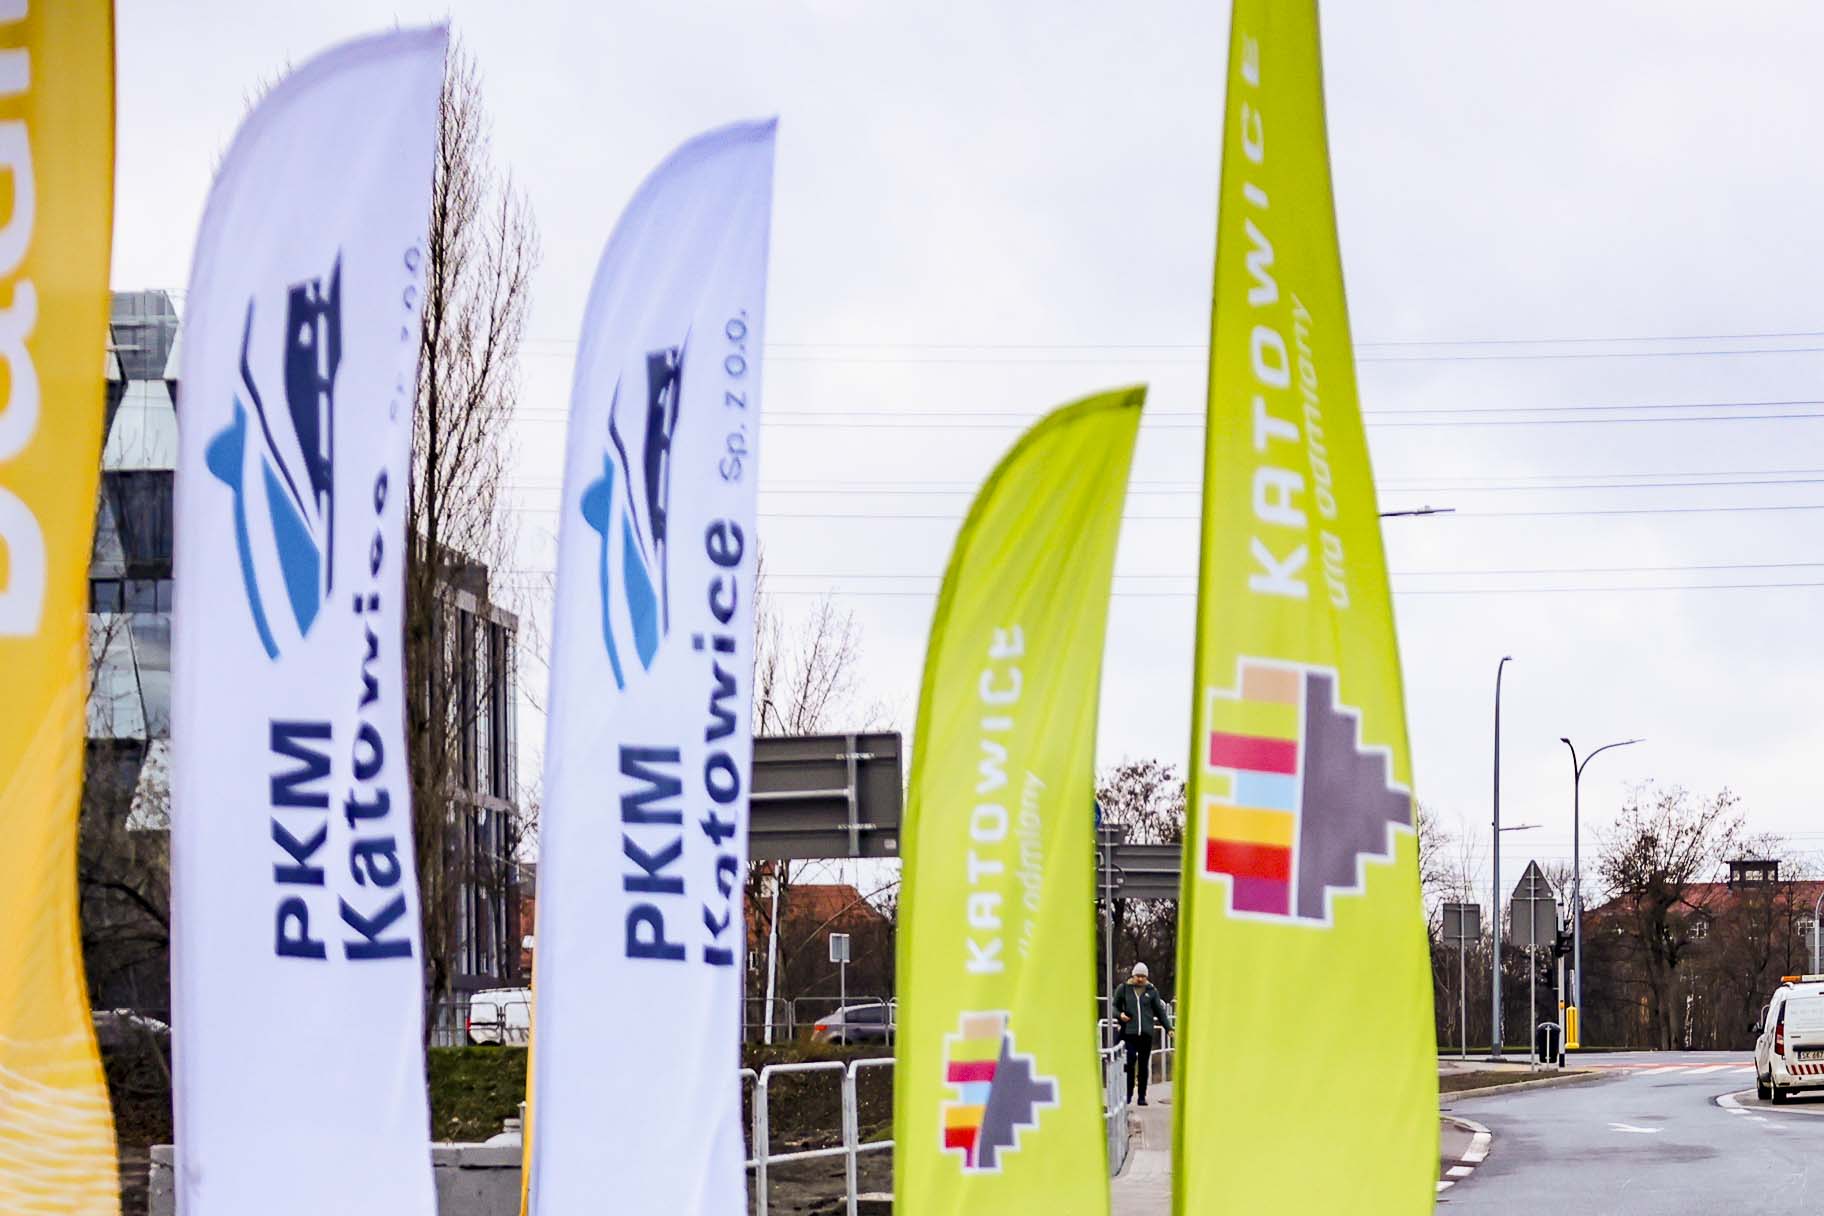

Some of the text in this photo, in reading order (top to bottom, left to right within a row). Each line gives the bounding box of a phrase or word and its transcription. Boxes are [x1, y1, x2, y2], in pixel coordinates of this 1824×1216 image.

[719, 309, 748, 481] Sp. z o.o.
[1240, 34, 1309, 599] KATOWICE
[269, 719, 333, 960] PKM
[619, 743, 687, 964] PKM
[965, 623, 1026, 975] KATOWICE
